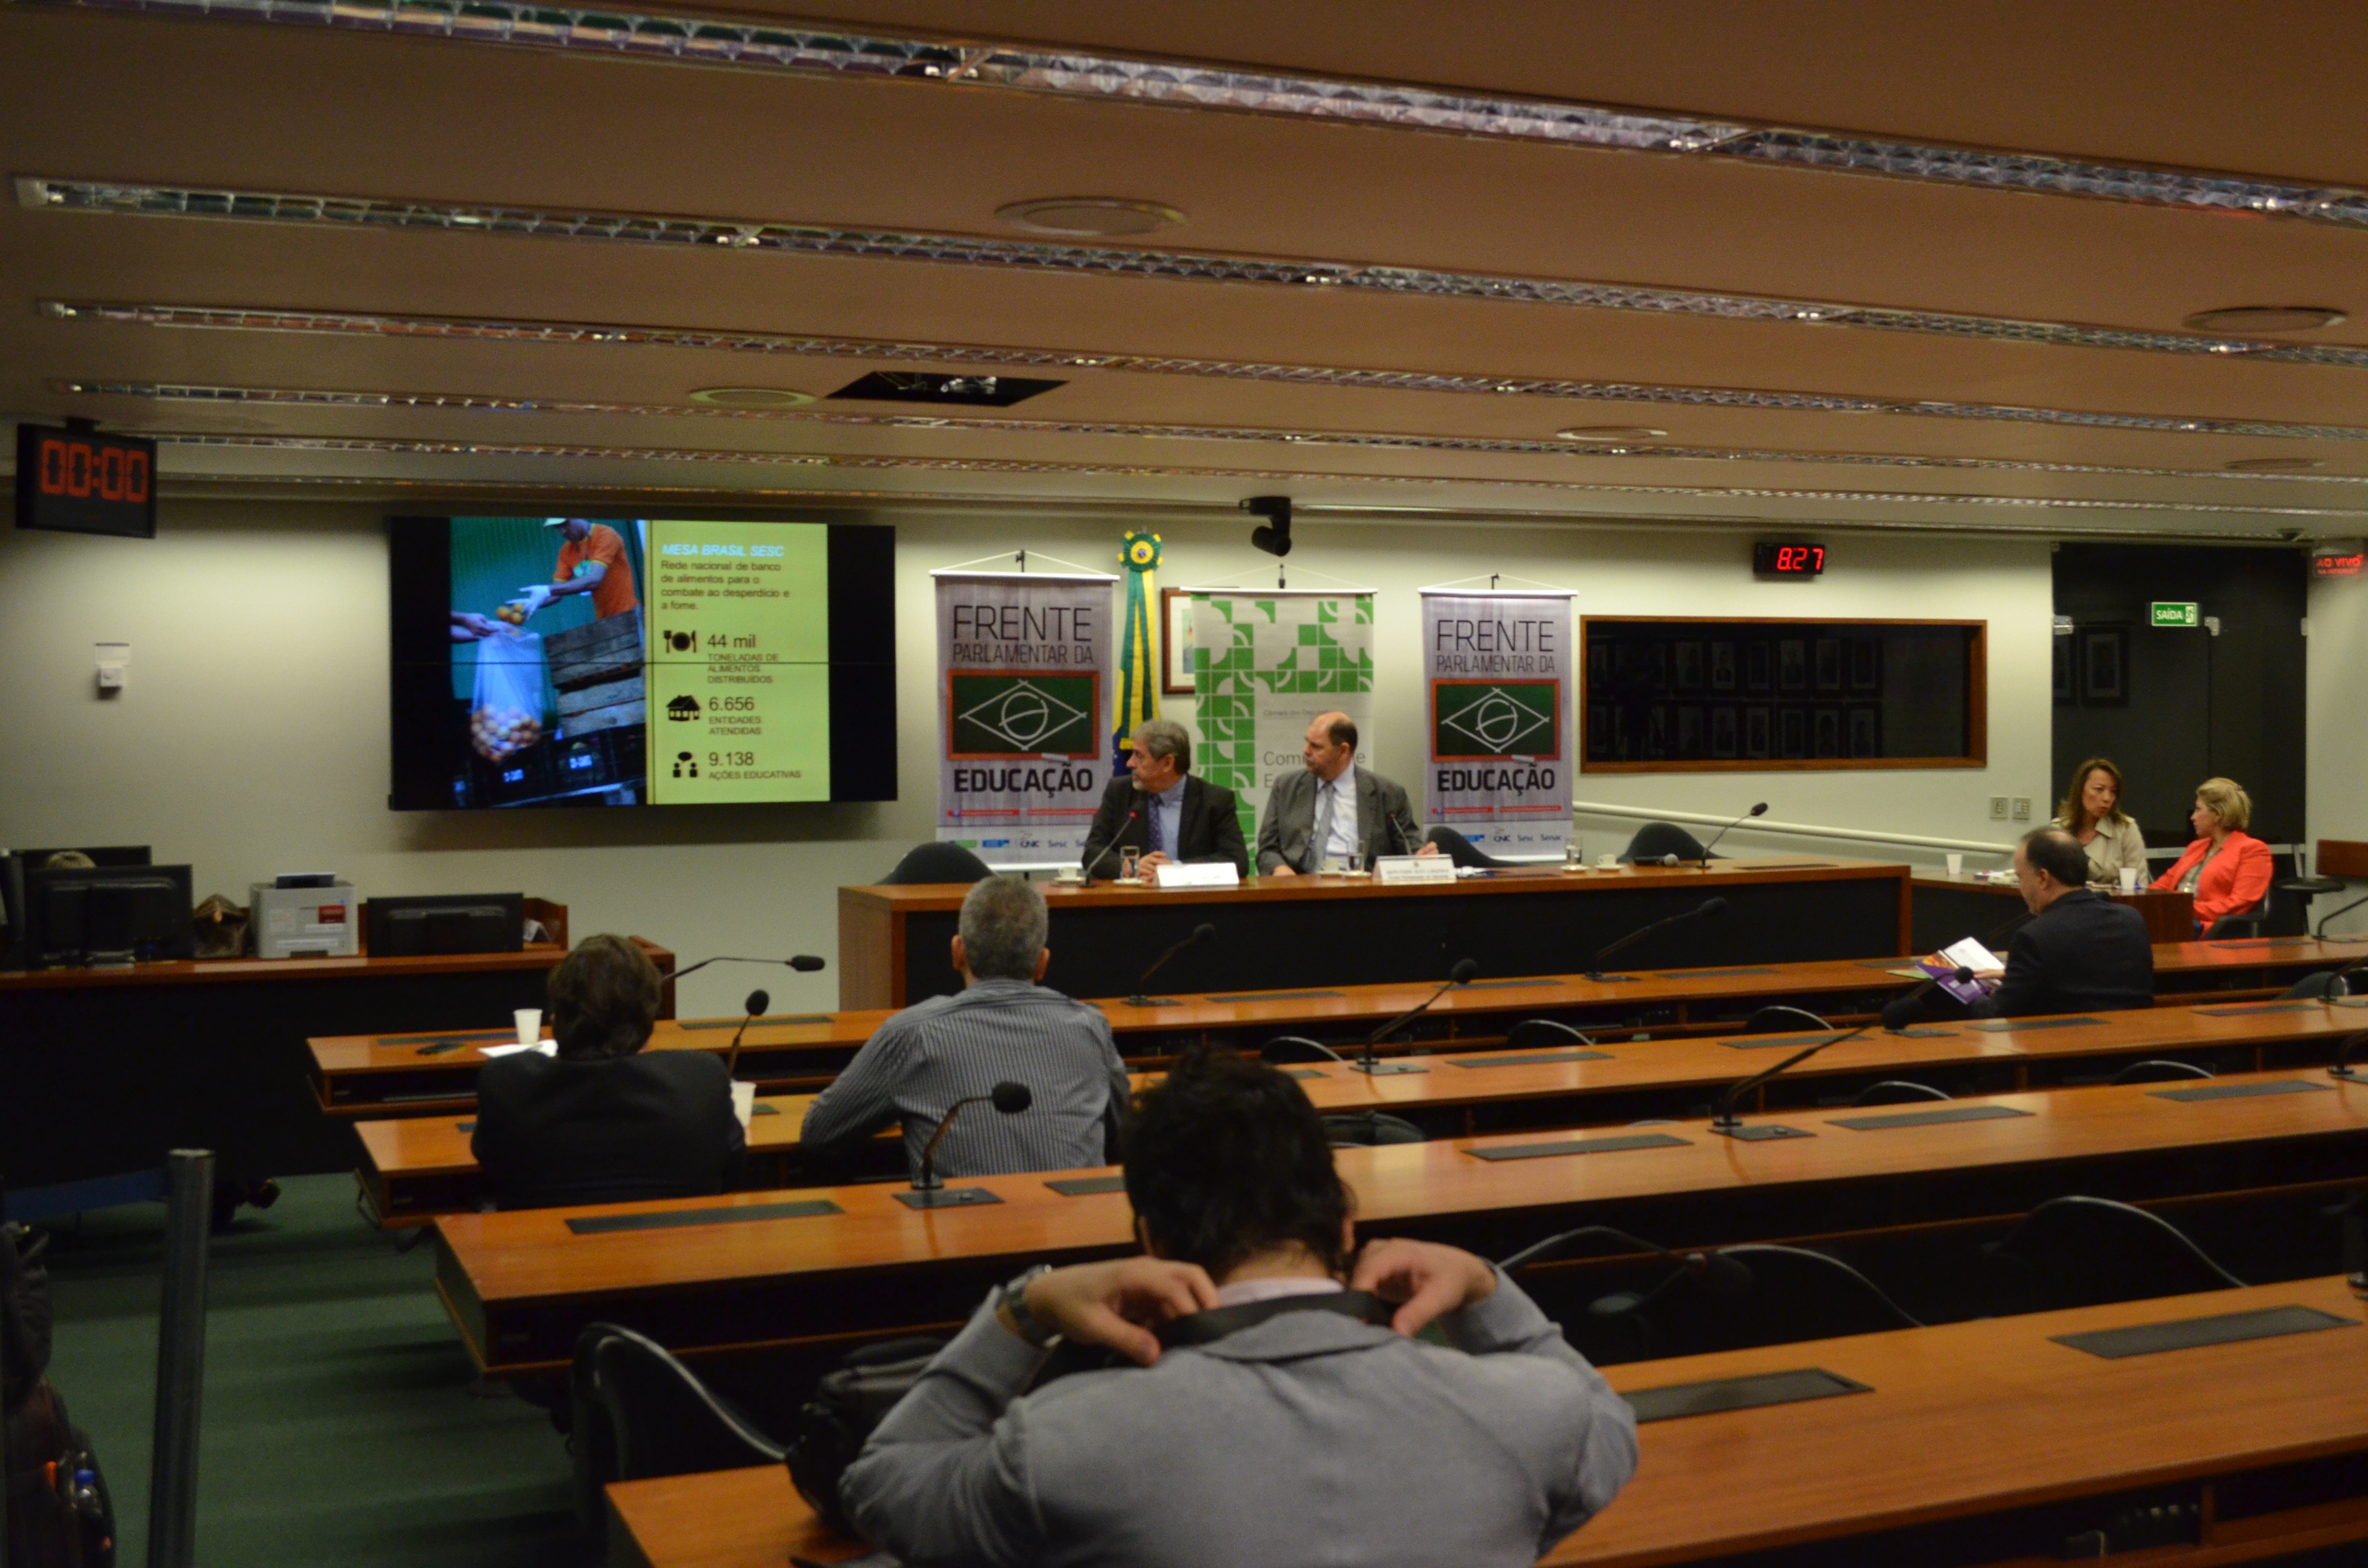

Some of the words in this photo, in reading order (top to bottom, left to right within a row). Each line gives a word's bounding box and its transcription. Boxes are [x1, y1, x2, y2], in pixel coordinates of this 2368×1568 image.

[40, 439, 149, 502] 00:00
[662, 544, 699, 555] MESA
[702, 544, 745, 556] BRASIL
[751, 545, 784, 557] SESC
[661, 560, 687, 569] Rede
[691, 562, 731, 571] nacional
[752, 563, 781, 571] banco
[2317, 558, 2332, 567] AO
[2335, 557, 2360, 566] VIVO
[671, 600, 698, 610] fome.
[2156, 608, 2183, 620] SAÍDA
[953, 605, 1092, 641] FRENTE
[707, 635, 727, 647] 44
[733, 635, 756, 648] mil
[1437, 620, 1554, 651] FRENTE
[953, 643, 1068, 663] PARLAMENTAR
[1074, 645, 1094, 663] DA
[1437, 655, 1534, 672] PARLAMENTAR
[1540, 656, 1555, 673] DA
[709, 697, 754, 711] 6.656
[709, 752, 754, 766] 9.138
[709, 770, 740, 780] AÇÕES
[744, 771, 801, 779] EDUCATIVAS
[954, 761, 1093, 798] EDUCAÇÃO
[1438, 763, 1555, 796] EDUCAÇÃO
